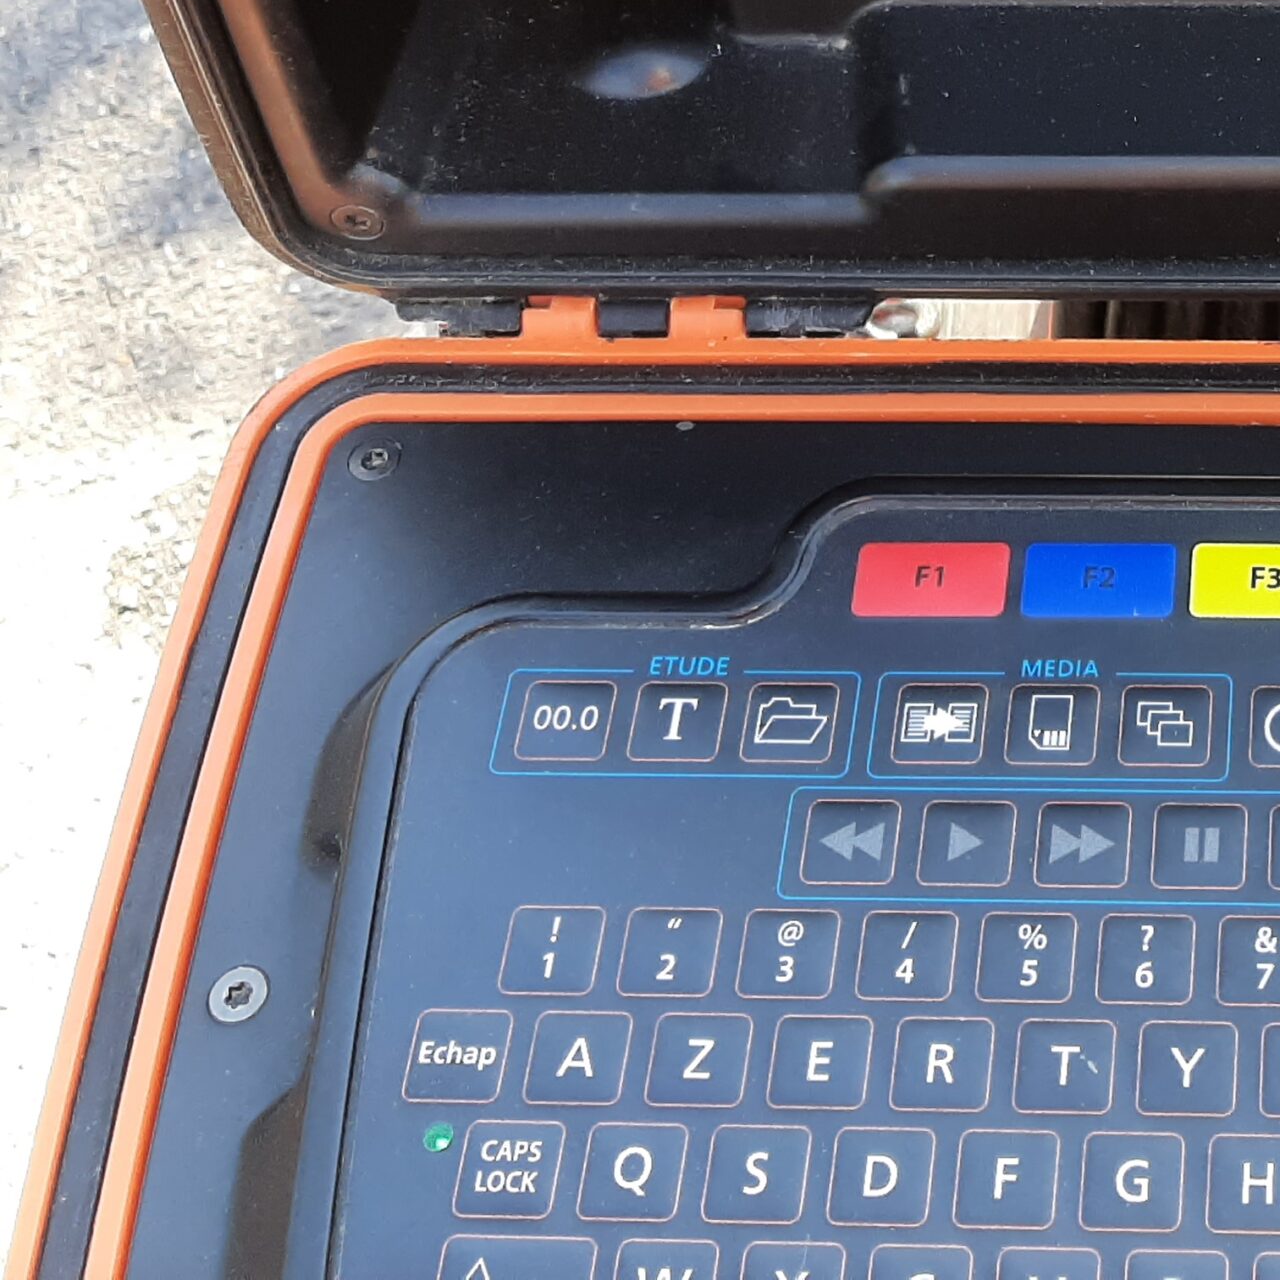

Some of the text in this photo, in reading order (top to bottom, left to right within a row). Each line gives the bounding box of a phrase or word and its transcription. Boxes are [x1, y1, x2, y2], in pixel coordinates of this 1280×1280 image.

[914, 565, 945, 588] F1
[1082, 566, 1116, 589] F2
[649, 656, 730, 677] ETUDE
[1020, 658, 1100, 679] MEDIA
[533, 705, 599, 731] 00.0
[658, 697, 699, 741] T
[542, 952, 555, 979] 1
[655, 953, 676, 980] 2
[775, 955, 794, 983] 3
[895, 958, 914, 984] 4
[1019, 959, 1038, 987] 5
[1135, 961, 1154, 988] 6
[1256, 963, 1275, 990] 7
[418, 1040, 496, 1070] Echap
[556, 1037, 593, 1077] A
[682, 1038, 715, 1079] Z
[806, 1041, 834, 1081] E
[926, 1043, 954, 1084] R
[1051, 1045, 1080, 1086] T
[1170, 1047, 1205, 1088] Y
[480, 1139, 543, 1163] CAPS
[474, 1170, 538, 1193] LOCK
[613, 1146, 652, 1196] Q
[742, 1151, 769, 1195] S
[862, 1155, 898, 1197] D
[993, 1157, 1020, 1200] F
[1115, 1159, 1149, 1203] G
[1241, 1162, 1275, 1205] H
